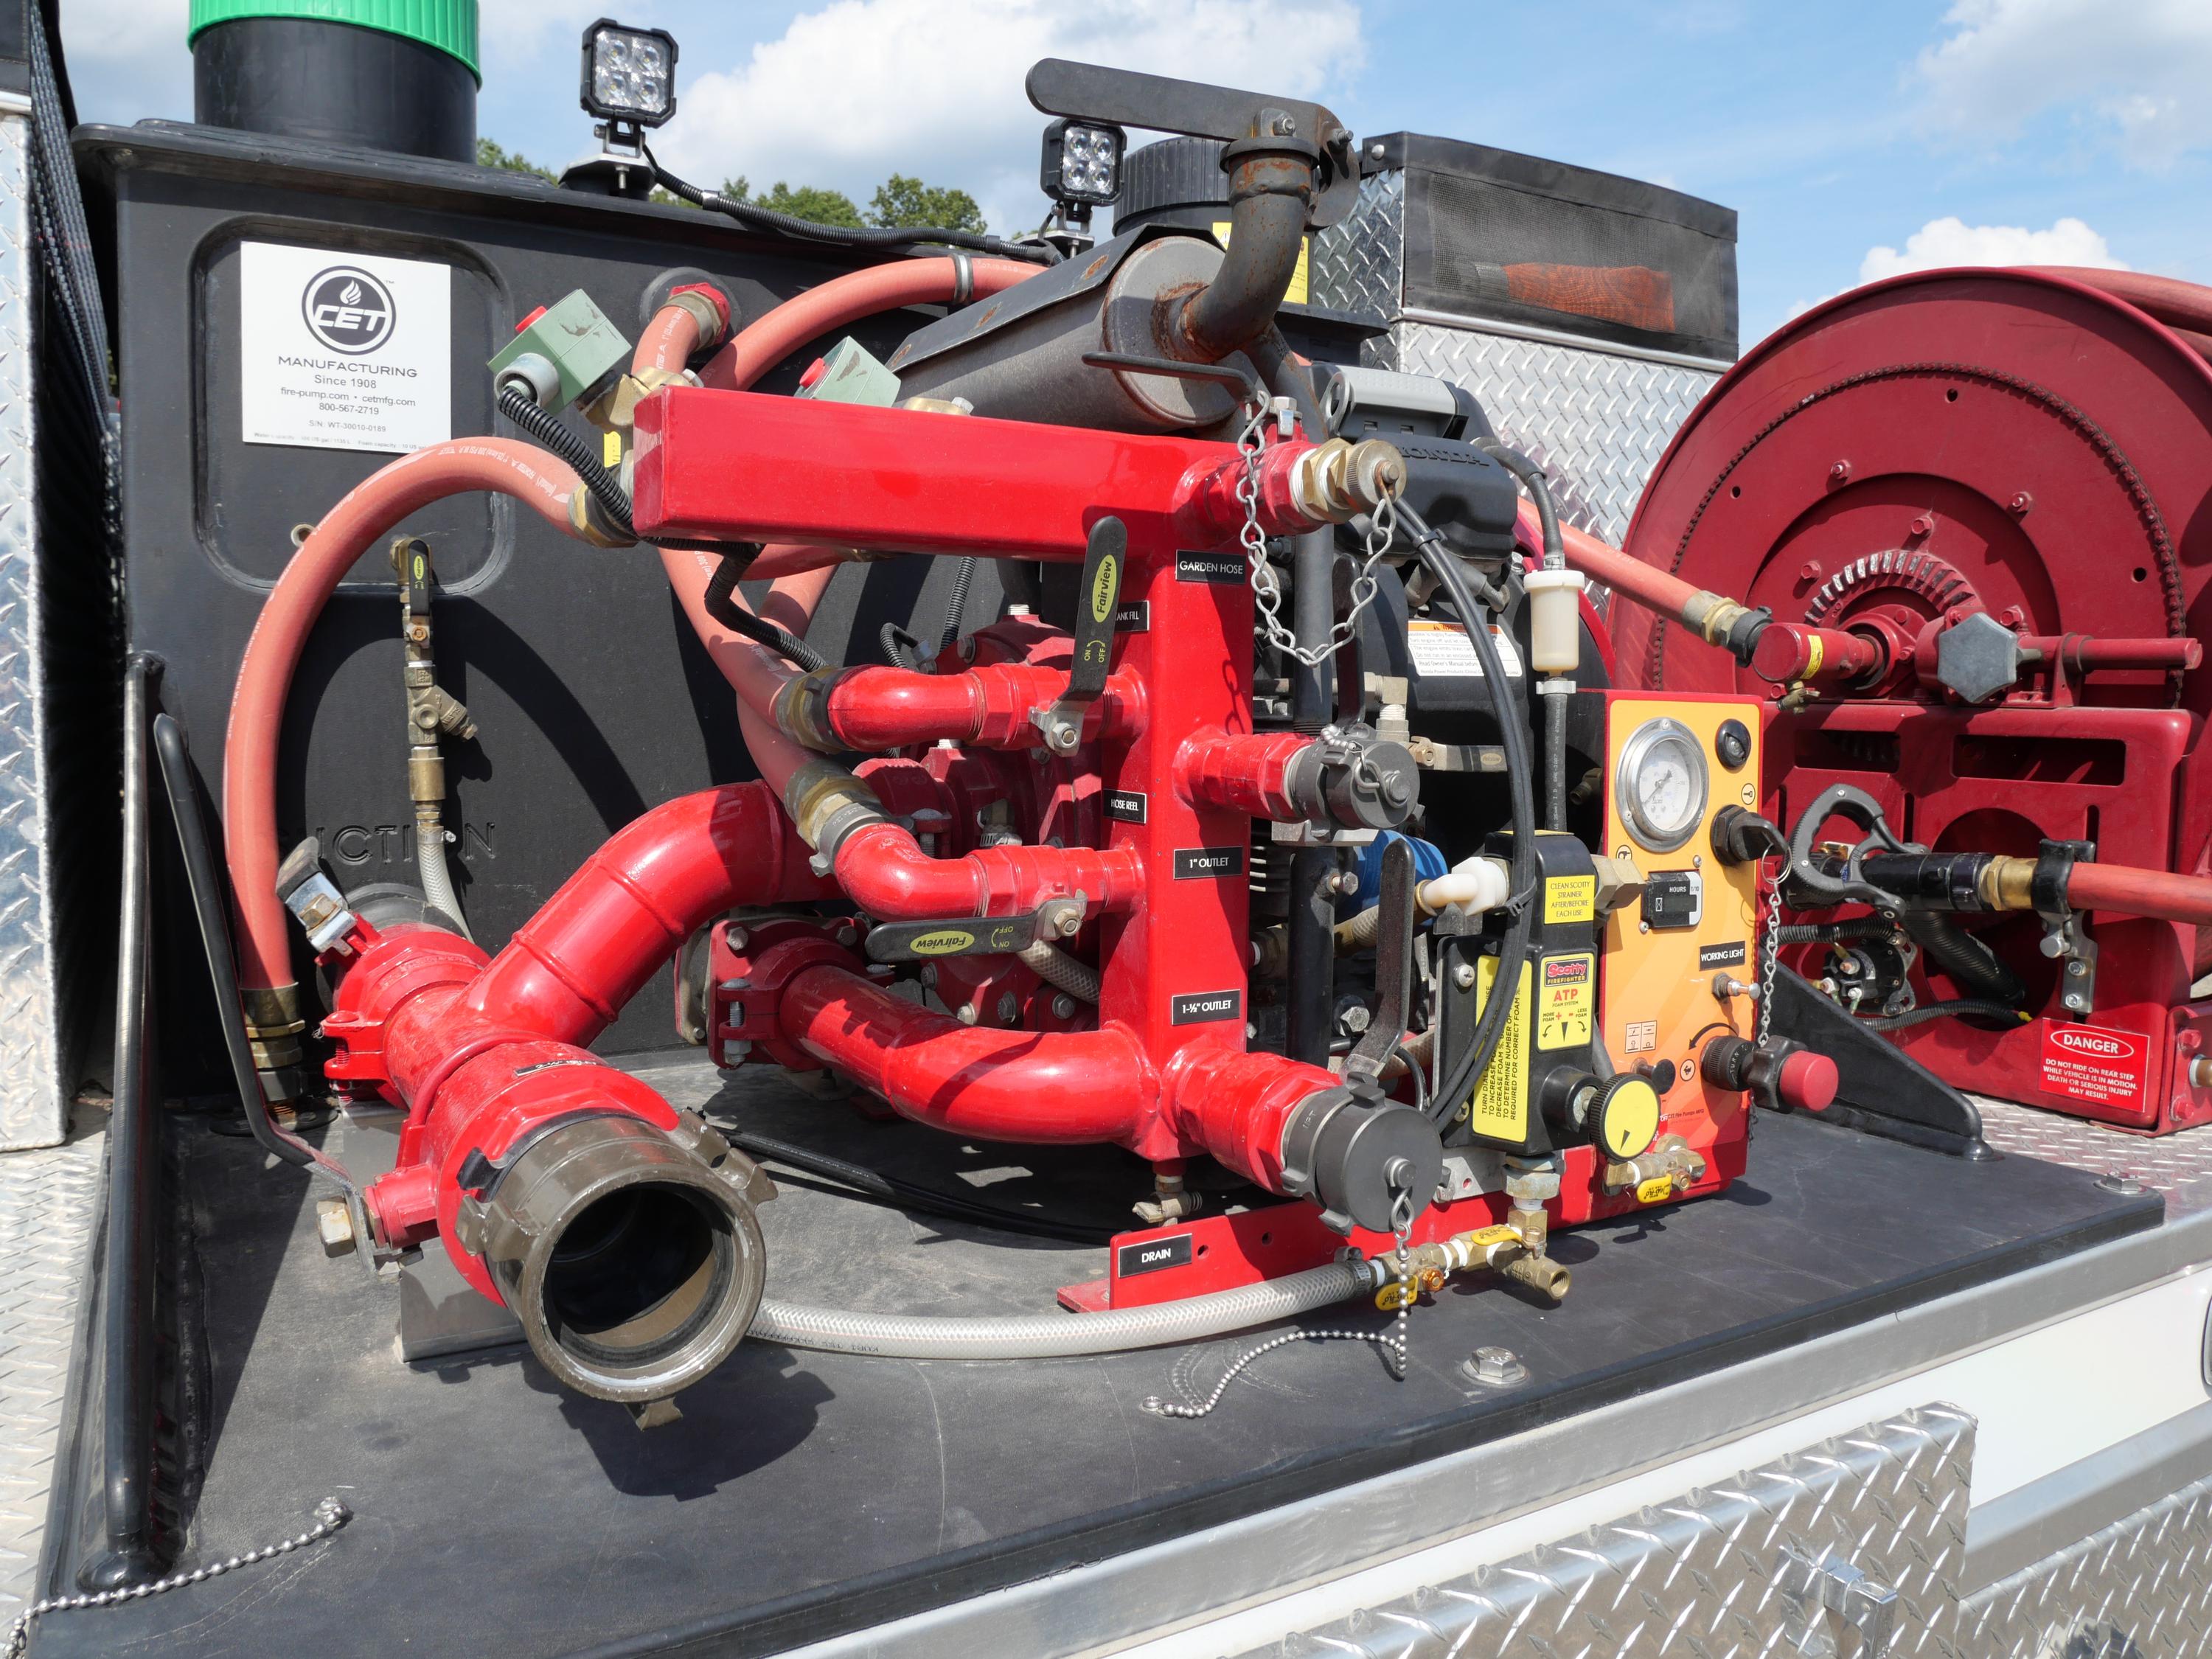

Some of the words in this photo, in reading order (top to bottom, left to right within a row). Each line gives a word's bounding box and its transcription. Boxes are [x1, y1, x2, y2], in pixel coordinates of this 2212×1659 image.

[314, 304, 386, 332] CET
[278, 355, 418, 378] MANUFACTURING
[315, 375, 347, 386] Since
[351, 378, 377, 389] 1908
[281, 387, 349, 400] fire-pump.com
[362, 394, 416, 406] cetmfg.com
[319, 403, 379, 415] 800-567-2719
[328, 422, 386, 432] WT-30010-0189
[1180, 560, 1217, 572] GARDEN
[1220, 564, 1243, 574] HOSE
[1096, 561, 1112, 613] Fairview
[1116, 611, 1129, 621] ANK
[1130, 611, 1139, 620] FILL
[1085, 650, 1091, 661] ON
[1110, 799, 1125, 809] HOSE
[1126, 801, 1138, 811] REEL
[316, 822, 495, 865] CTIN
[1189, 858, 1197, 868] 1"
[1199, 858, 1229, 867] OUTLET
[1551, 900, 1588, 908] AFTER/BEFORE
[915, 935, 966, 949] Fairview
[999, 940, 1009, 948] ON
[1700, 951, 1728, 961] WORKING
[1729, 948, 1744, 958] LIGHT
[1548, 963, 1586, 978] Scotty
[1548, 975, 1585, 984] FIREFIGHTER
[1554, 989, 1578, 1001] ATP
[1202, 1000, 1231, 1012] OUTLET
[2064, 1034, 2118, 1054] DANGER
[1730, 1052, 1739, 1074] TURN
[2043, 1065, 2062, 1074] WHILE
[2064, 1070, 2090, 1080] VEHICLE
[2107, 1079, 2138, 1090] MOTION.
[2073, 1062, 2087, 1071] RIDE
[2101, 1069, 2118, 1078] REAR
[2120, 1072, 2135, 1080] STEP
[2048, 1075, 2067, 1084] DEATH
[2080, 1081, 2107, 1091] SERIOUS
[2108, 1087, 2132, 1096] INJURY
[2068, 1087, 2084, 1095] MAY
[2085, 1091, 2109, 1100] RESULT.
[1489, 1105, 1495, 1115] TO
[1503, 1108, 1509, 1119] TO
[1141, 1248, 1171, 1263] DRAIN
